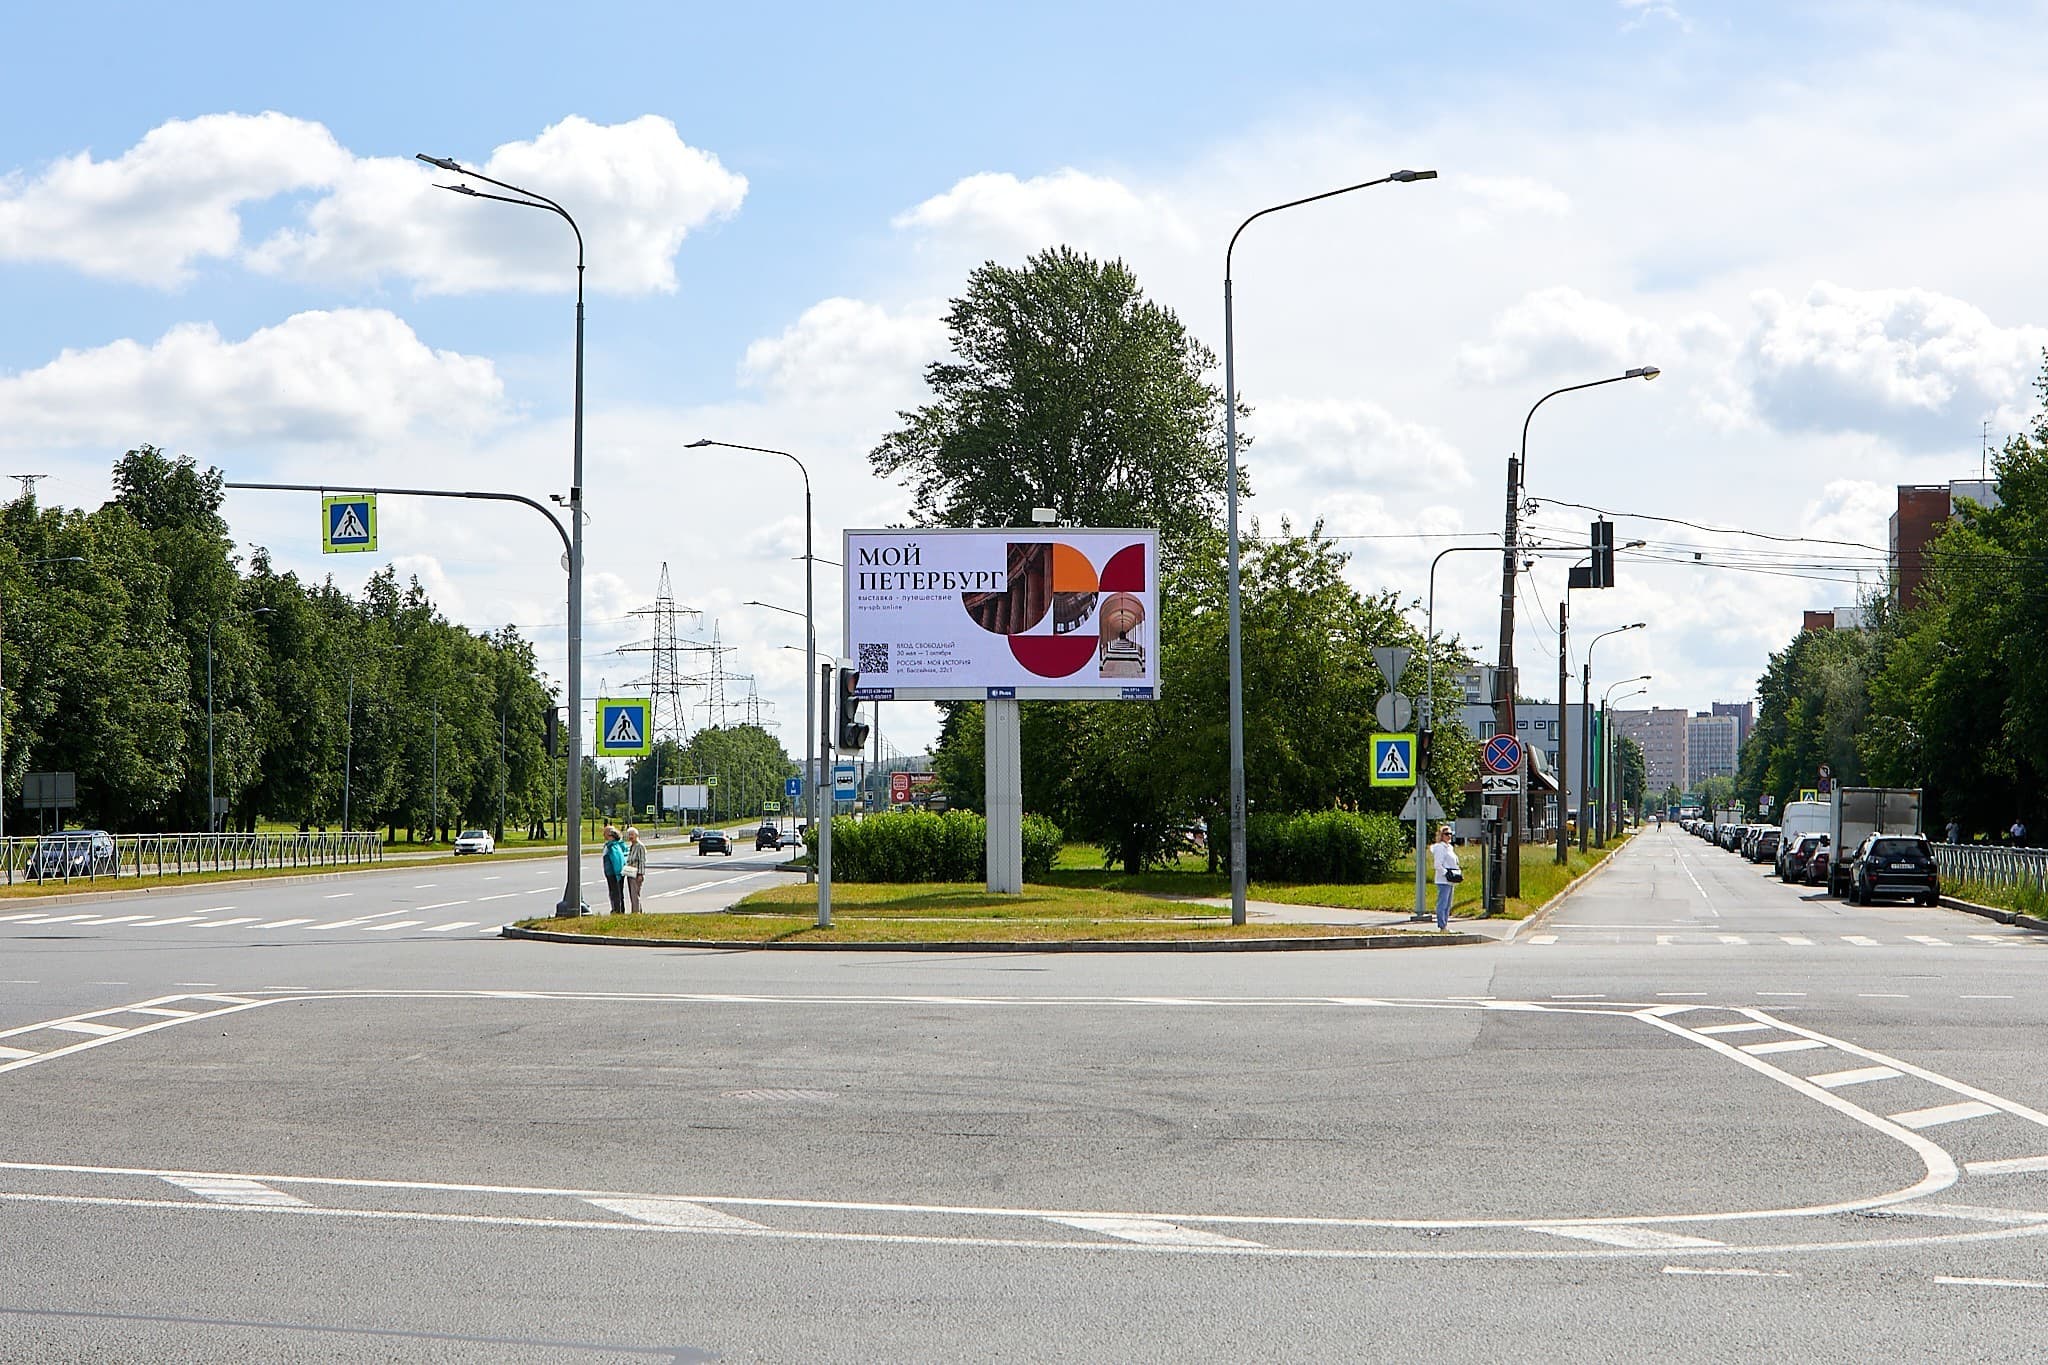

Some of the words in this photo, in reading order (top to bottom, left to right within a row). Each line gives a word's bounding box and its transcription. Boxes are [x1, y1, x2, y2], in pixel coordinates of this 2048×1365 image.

[859, 543, 921, 566] МОЙ
[859, 571, 1004, 590] ПЕТЕРБУРГ
[915, 641, 955, 649] СВОБОДНЫЙ
